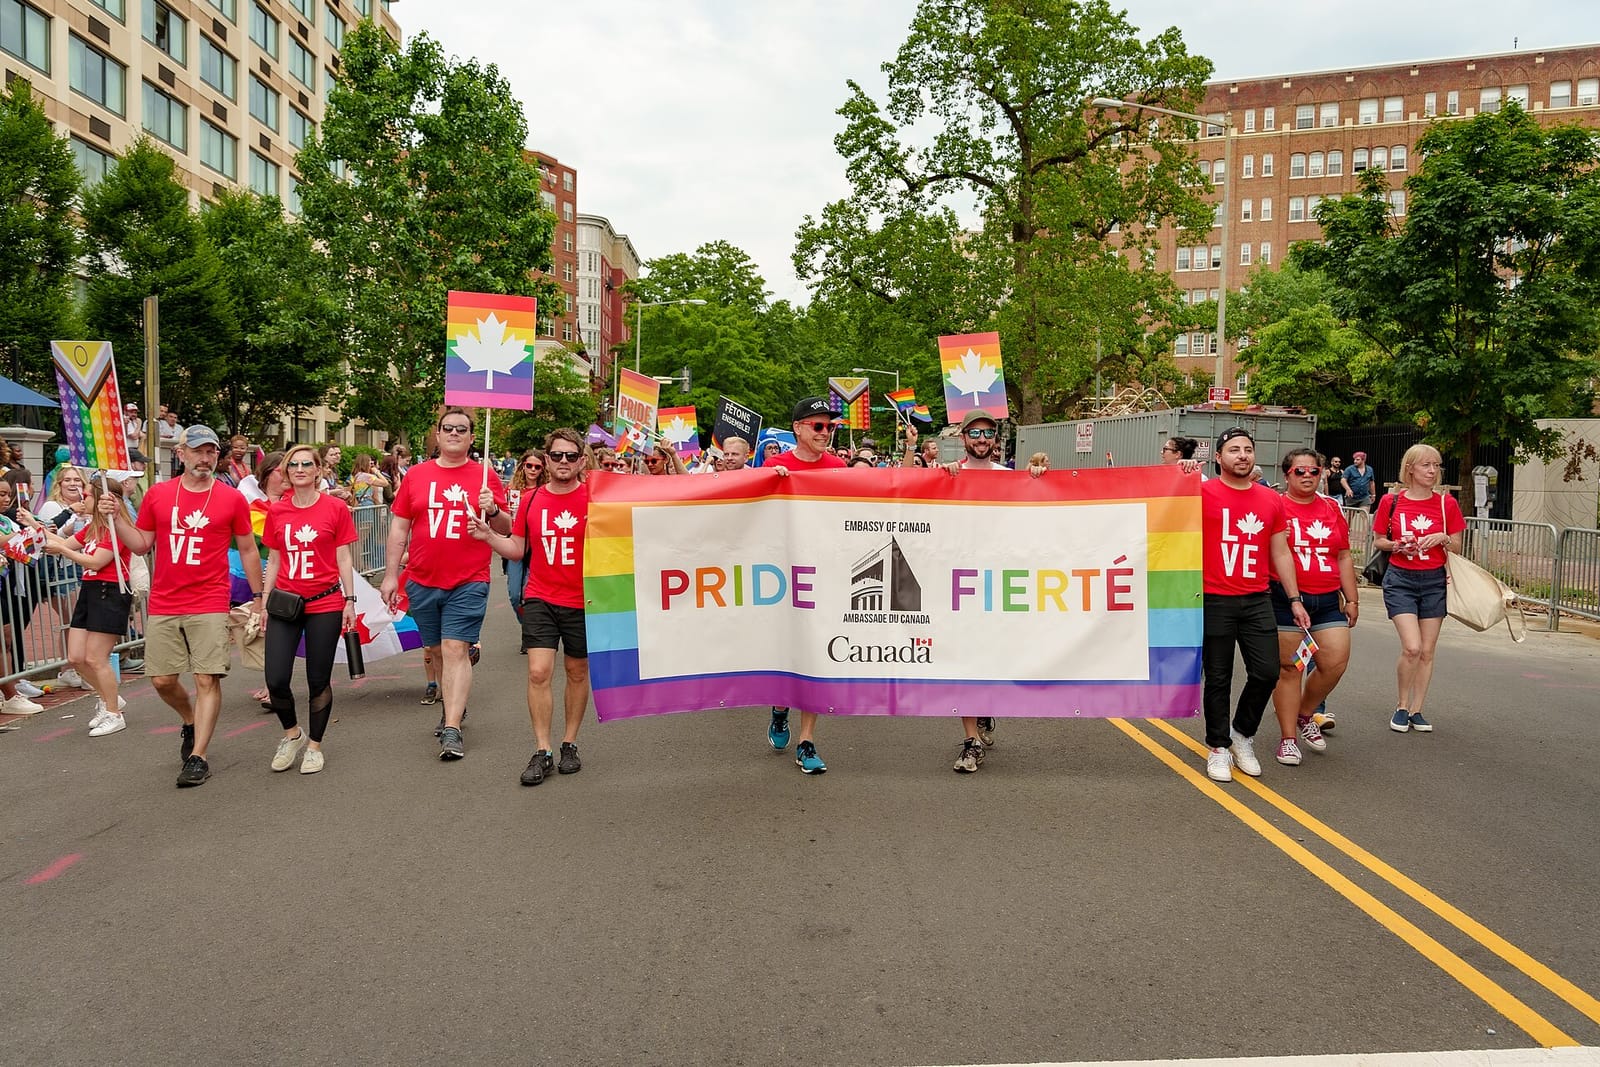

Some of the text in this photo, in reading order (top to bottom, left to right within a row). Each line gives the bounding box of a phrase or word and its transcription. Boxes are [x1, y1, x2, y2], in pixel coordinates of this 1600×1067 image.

[620, 395, 652, 426] PRIDE
[721, 412, 751, 434] ENSEMBLE!
[724, 402, 751, 424] FÊTONS
[844, 520, 932, 534] EMBASSY OF CANADA
[660, 564, 817, 611] PRIDE
[952, 554, 1134, 612] FIERTÉ
[843, 613, 930, 625] AMBASSADE DU CANADA
[827, 635, 933, 664] Canada
